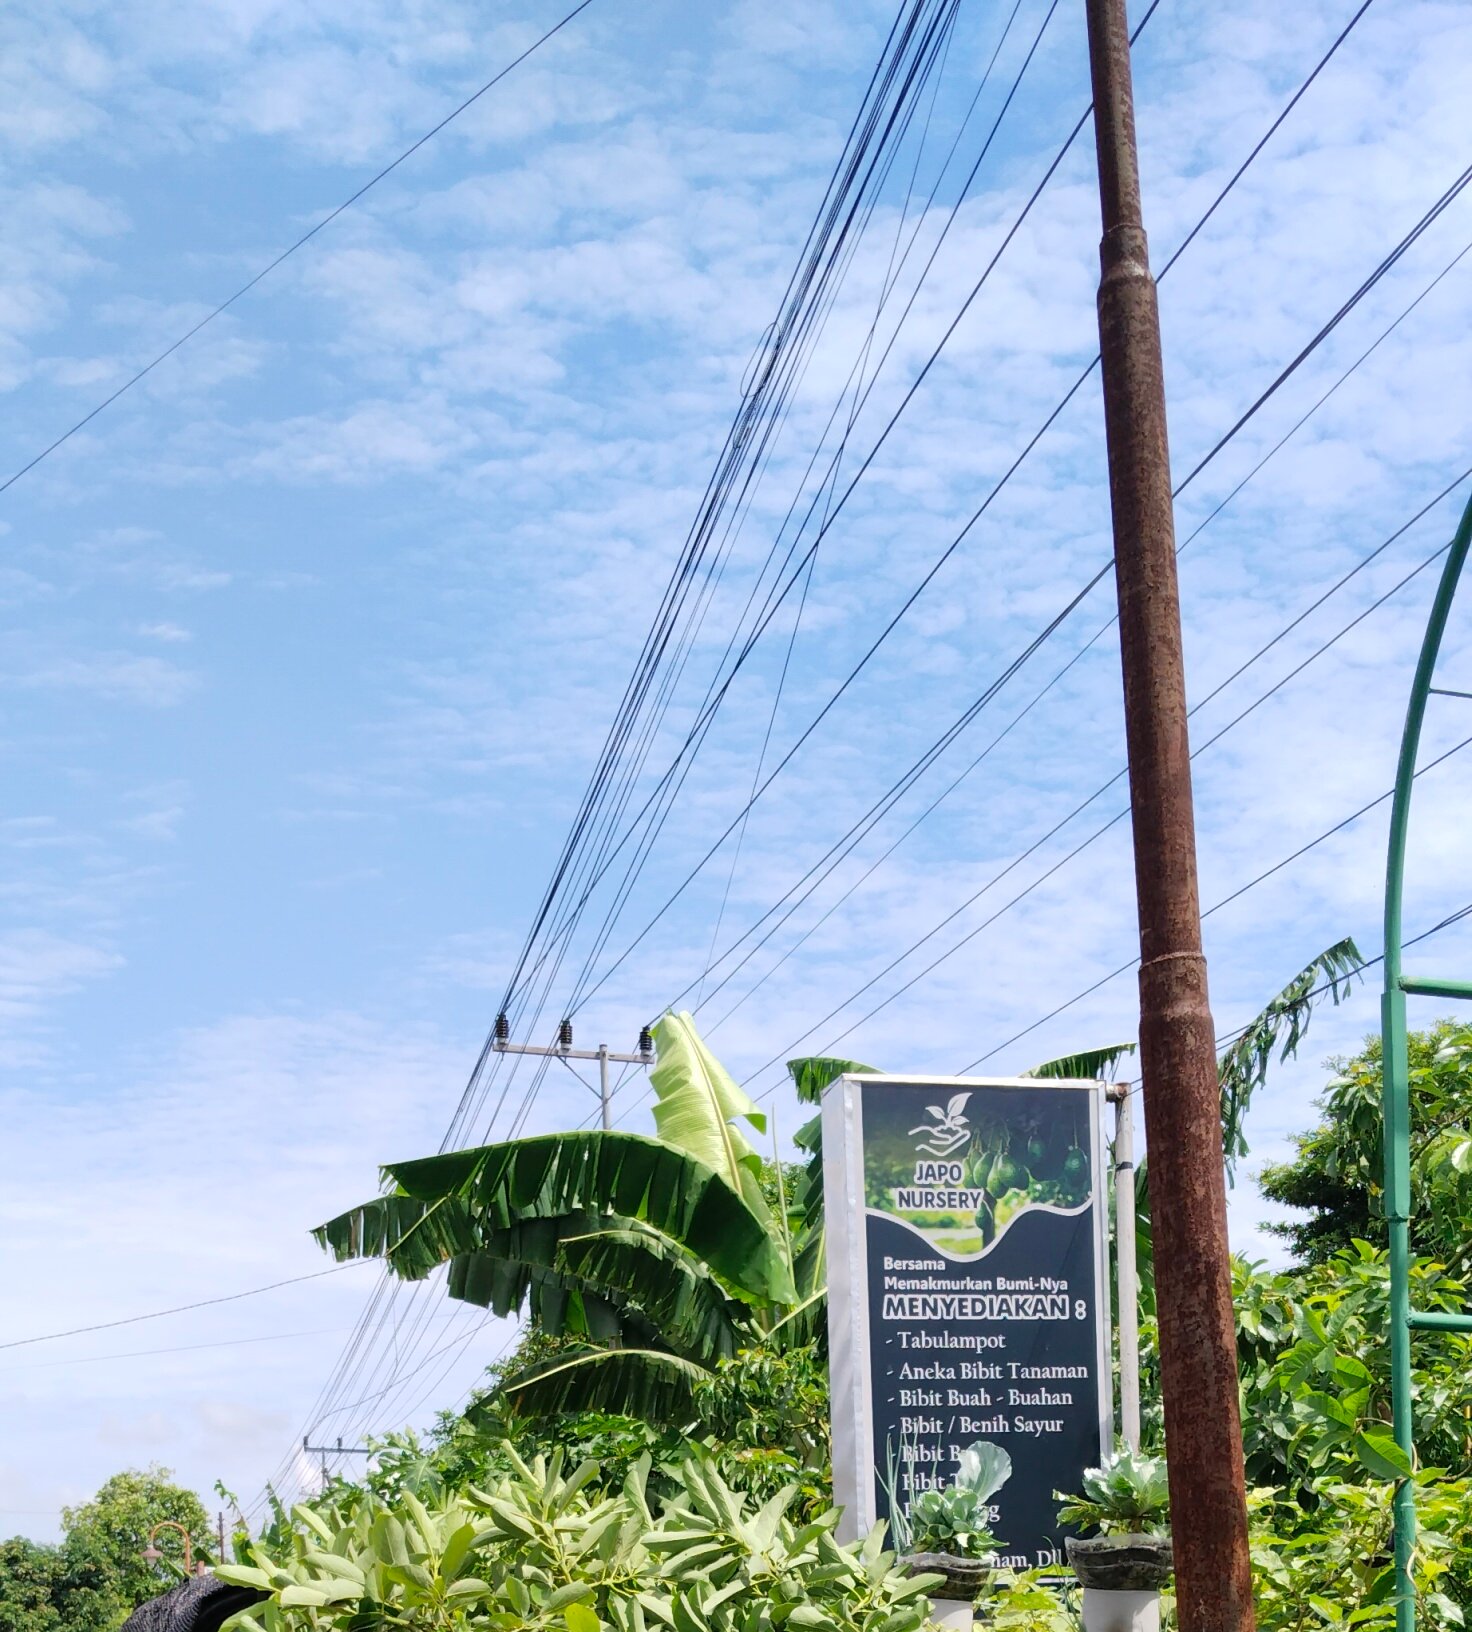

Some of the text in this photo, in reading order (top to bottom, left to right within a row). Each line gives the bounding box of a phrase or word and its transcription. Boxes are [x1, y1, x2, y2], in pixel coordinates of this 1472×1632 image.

[916, 1162, 963, 1183] JAPO
[897, 1189, 983, 1210] NURSERY
[883, 1257, 946, 1271] Bersama
[884, 1277, 1068, 1293] Memakmurkan Bumi-Nya
[883, 1295, 1069, 1320] MENYEDIAKAN
[897, 1331, 1006, 1354] Tabulampot
[899, 1362, 956, 1380] Aneka
[960, 1362, 1003, 1380] Bibit
[1006, 1362, 1088, 1379] Tanaman
[900, 1389, 943, 1407] Bibit
[947, 1389, 992, 1406] Buah
[1008, 1389, 1073, 1405] Buahan
[900, 1416, 944, 1434] Bibit
[959, 1415, 1010, 1433] Benih
[1014, 1416, 1064, 1437] Sayur
